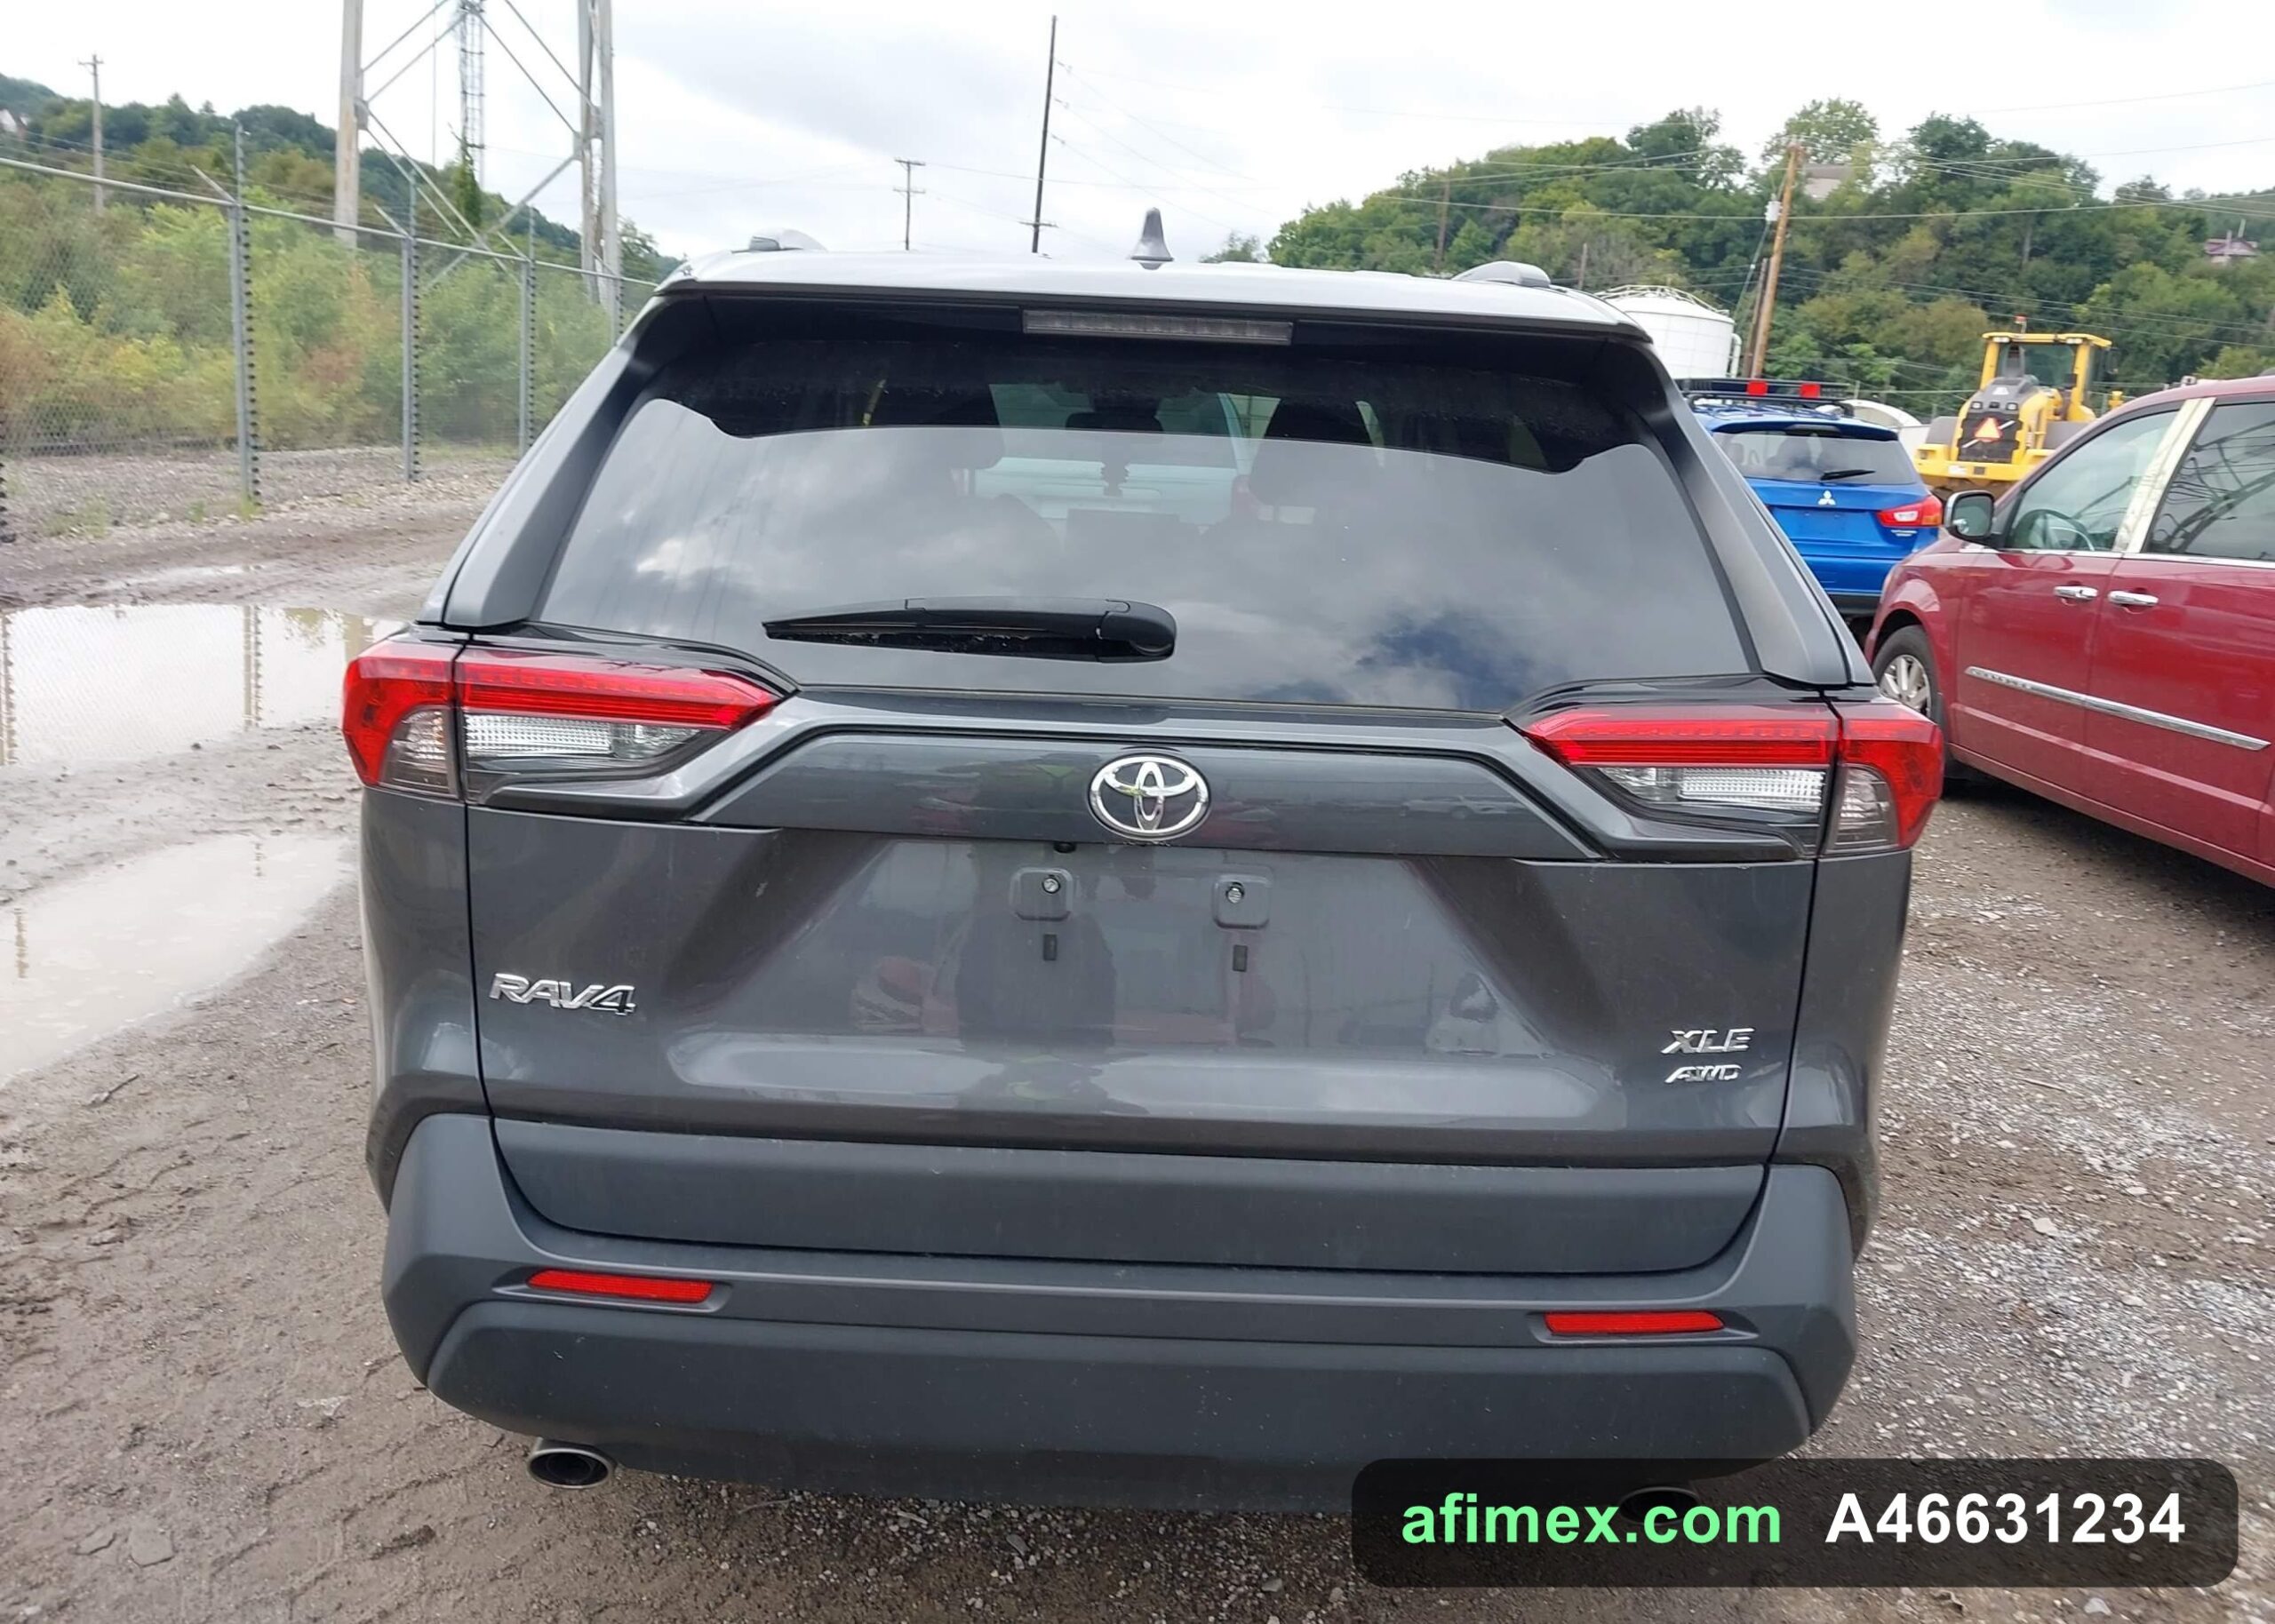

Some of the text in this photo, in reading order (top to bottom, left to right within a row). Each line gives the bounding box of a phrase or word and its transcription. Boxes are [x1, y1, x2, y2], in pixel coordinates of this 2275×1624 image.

[489, 973, 636, 1015] RAV4
[1660, 1027, 1755, 1054] XLE
[1664, 1063, 1742, 1083] AWD
